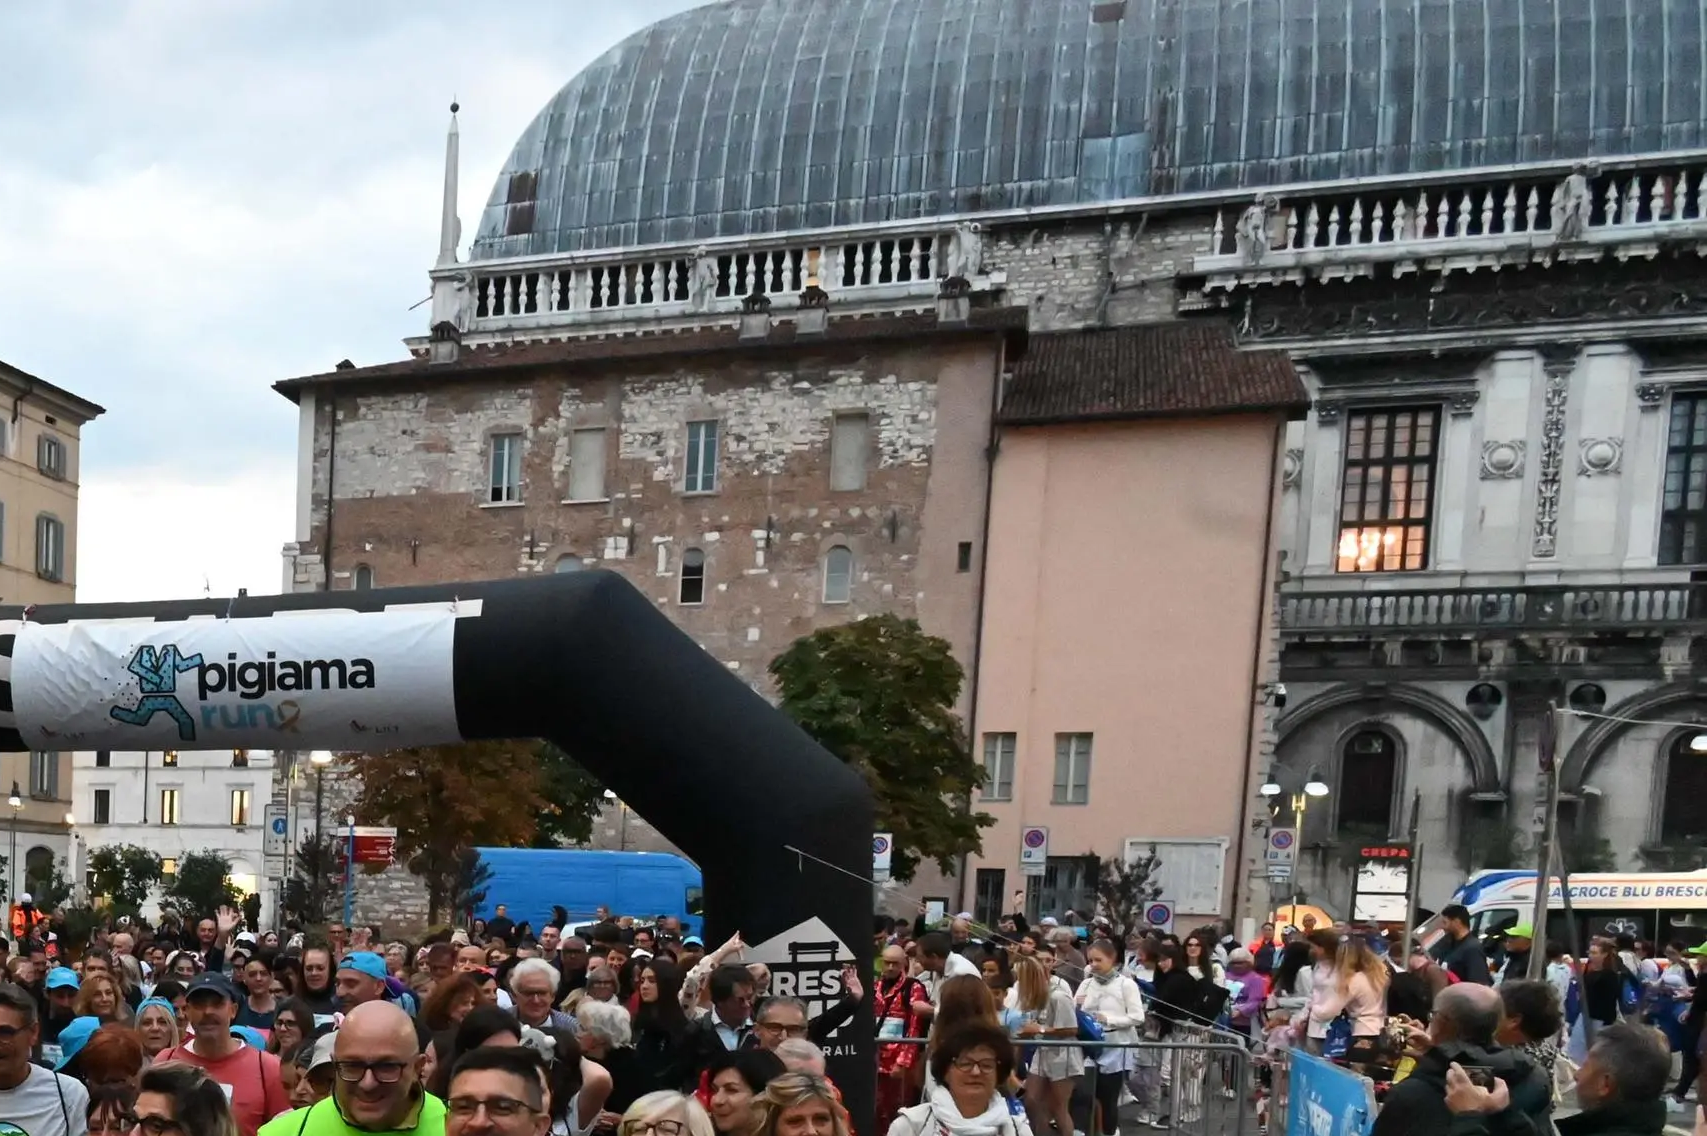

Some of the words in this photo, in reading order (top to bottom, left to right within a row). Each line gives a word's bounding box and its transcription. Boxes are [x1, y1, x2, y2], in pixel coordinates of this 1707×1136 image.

[196, 651, 375, 701] pigiama
[202, 702, 275, 731] run
[1568, 886, 1618, 898] CROCE
[1621, 886, 1651, 898] BLU
